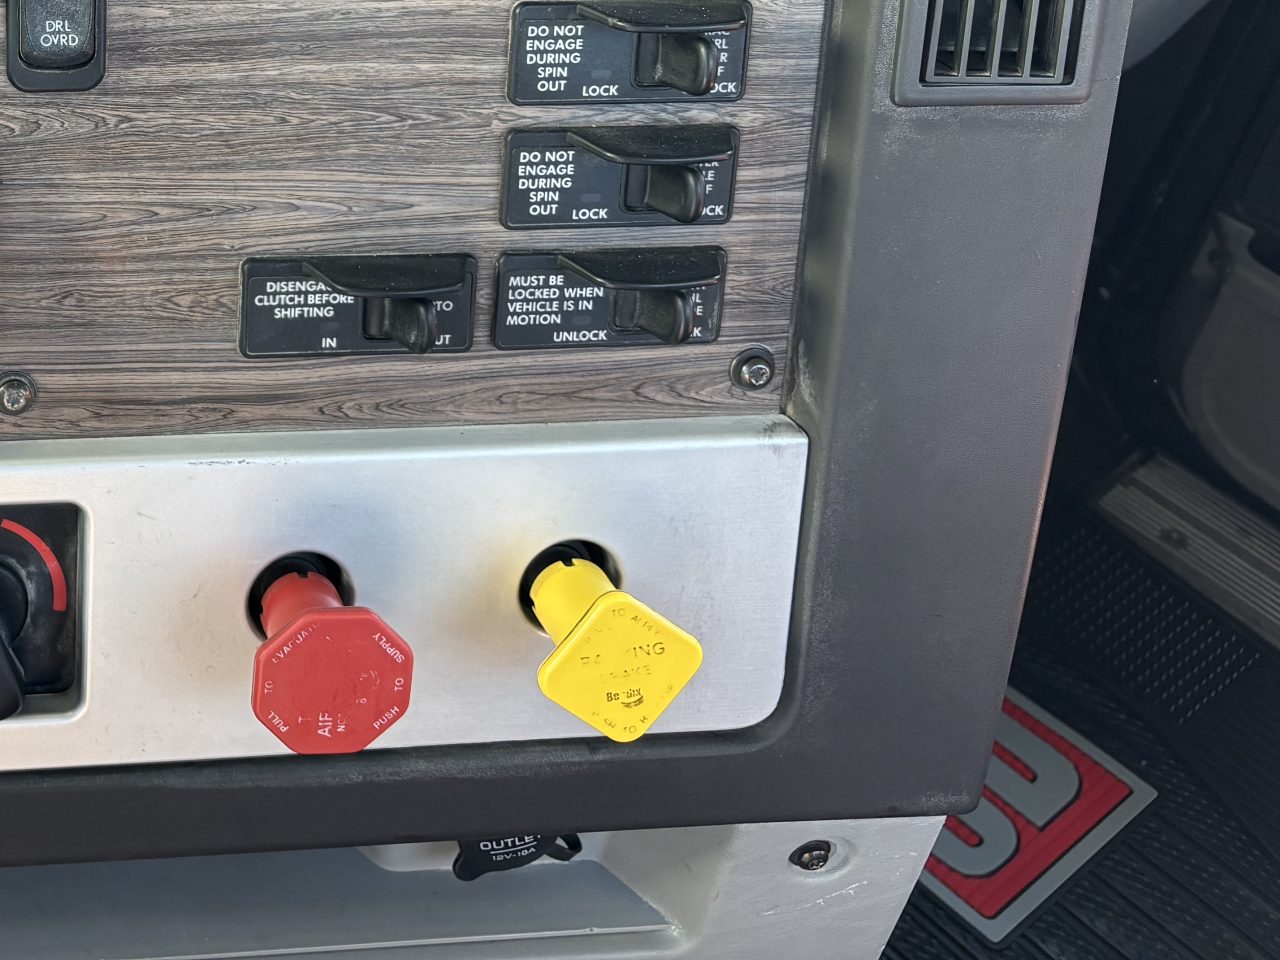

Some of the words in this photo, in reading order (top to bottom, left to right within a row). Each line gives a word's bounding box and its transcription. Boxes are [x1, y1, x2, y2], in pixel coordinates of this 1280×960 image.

[46, 20, 71, 32] DRL
[528, 26, 549, 36] DO
[554, 25, 584, 36] NOT
[41, 34, 78, 46] OVRD
[526, 39, 583, 50] ENGAGE
[527, 53, 580, 64] DURING
[538, 67, 567, 78] SPIN
[538, 80, 567, 91] OUT
[583, 85, 618, 96] LOCK
[520, 152, 541, 162] DO
[545, 151, 575, 161] NOT
[519, 164, 574, 176] ENGAGE
[519, 178, 572, 189] DURING
[530, 191, 558, 202] SPIN
[530, 204, 558, 215] OUT
[573, 209, 607, 219] LOCK
[509, 276, 545, 286] MUST
[549, 275, 564, 285] BE
[509, 288, 559, 299] LOCKED
[564, 287, 603, 297] WHEN
[255, 295, 304, 305] CLUTCH
[308, 294, 354, 304] BEFORE
[508, 301, 559, 312] VEHICLE
[564, 301, 574, 310] IS
[579, 300, 592, 310] IN
[274, 307, 334, 318] SHIFTING
[507, 314, 561, 325] MOTION
[554, 330, 606, 341] UNLOCK
[322, 338, 336, 347] IN
[372, 633, 405, 663] SUPPLY
[264, 680, 274, 694] TO
[394, 677, 404, 692] TO
[269, 711, 289, 733] PULL
[373, 705, 400, 730] PUSH
[492, 847, 536, 861] 12V-10A
